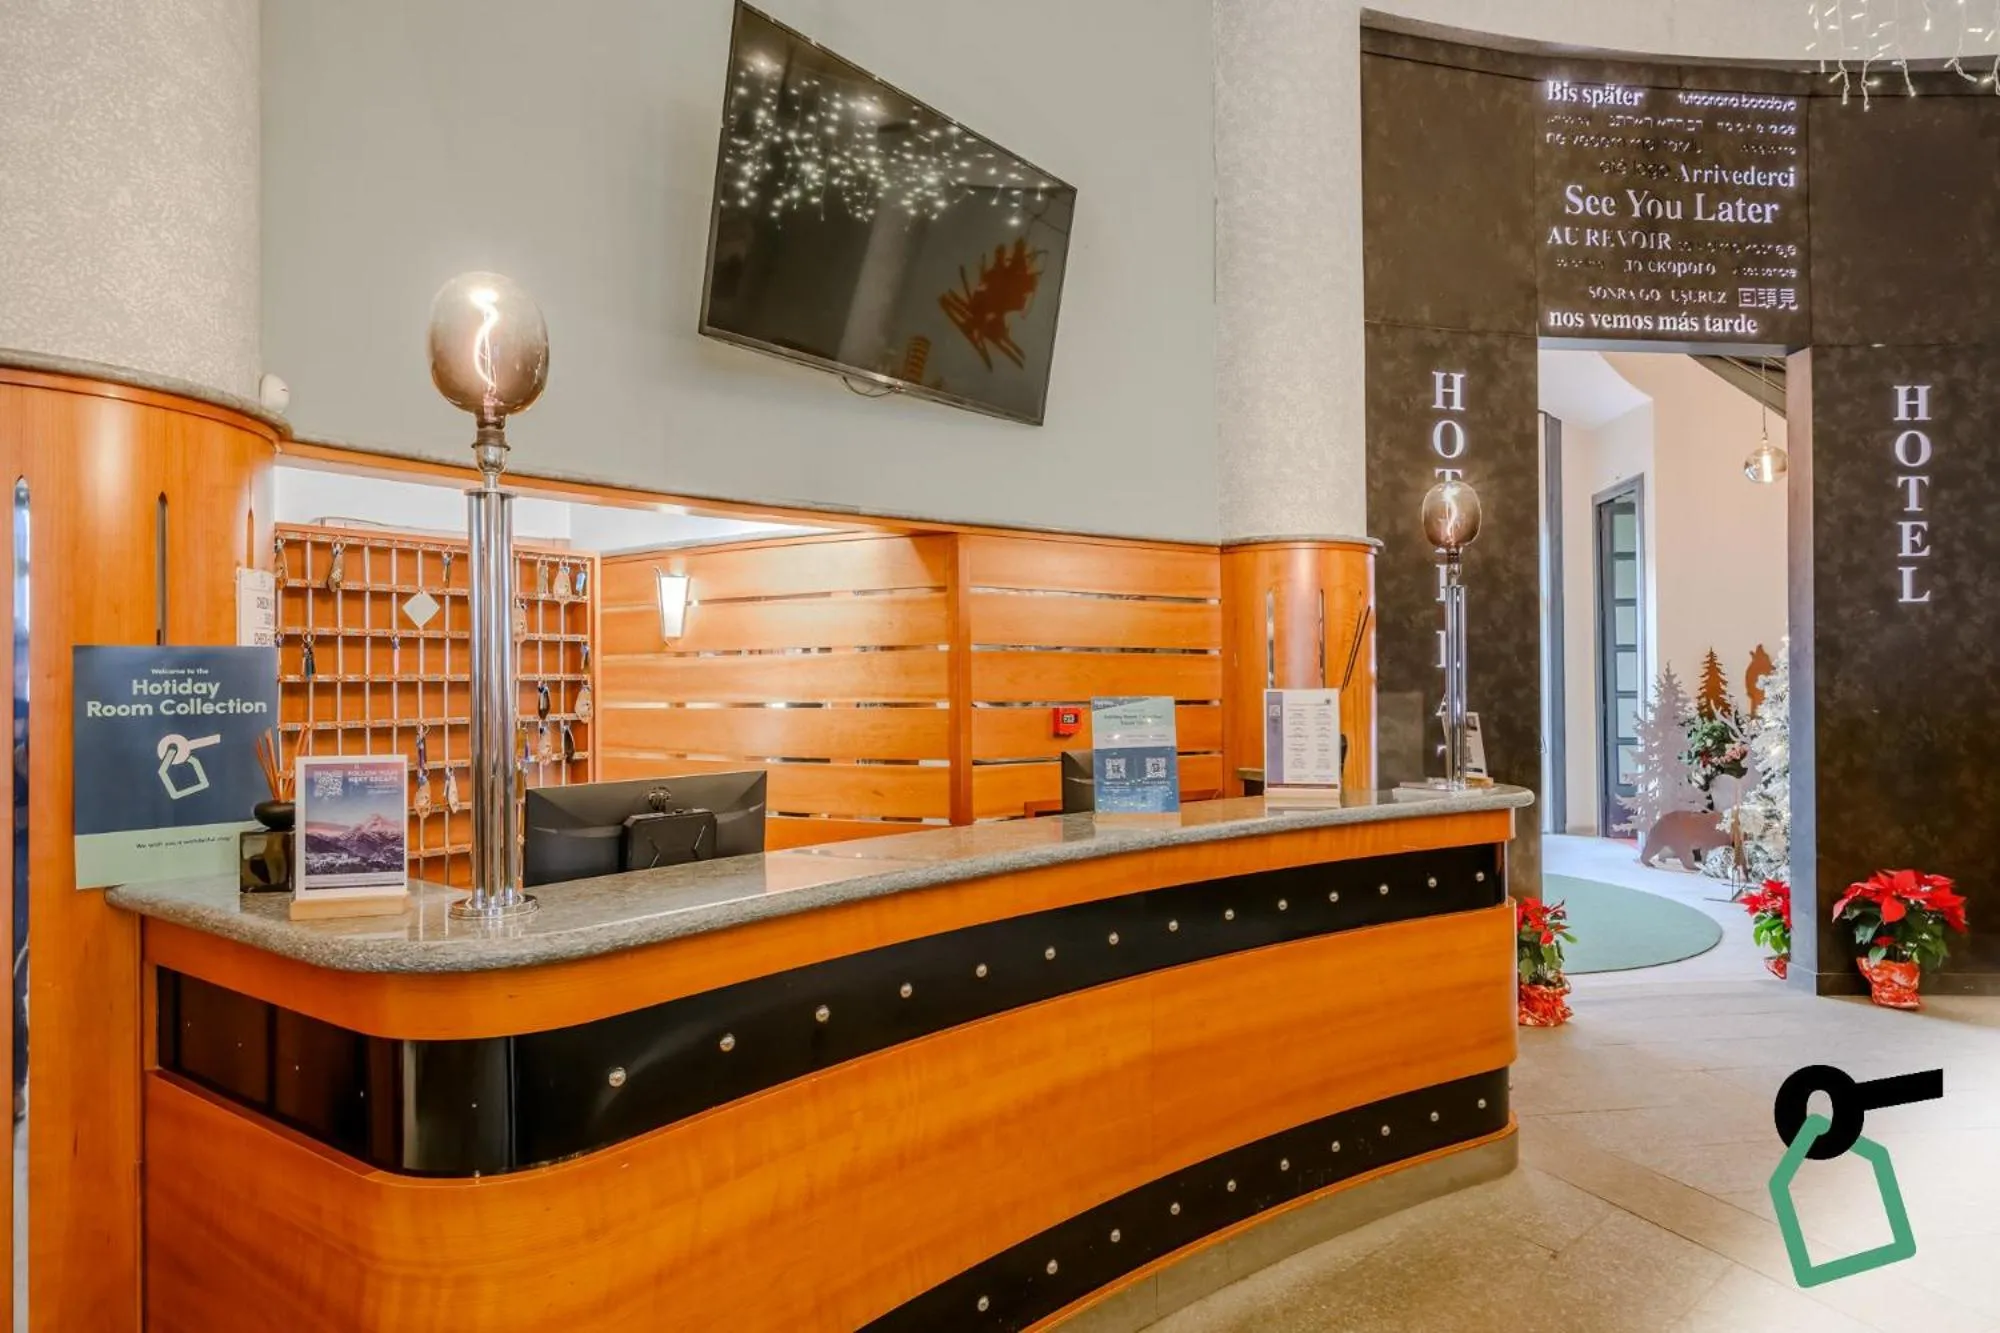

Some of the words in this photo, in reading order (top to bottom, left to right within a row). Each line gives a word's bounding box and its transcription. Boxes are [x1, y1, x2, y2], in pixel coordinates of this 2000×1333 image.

[1547, 80, 1577, 102] Bis
[1582, 83, 1644, 108] später
[1675, 163, 1796, 188] Arrivederci
[1564, 185, 1616, 217] See
[1626, 189, 1682, 220] You
[1694, 193, 1779, 223] Later
[1546, 227, 1580, 246] AU
[1585, 229, 1672, 250] REVOIR
[1549, 311, 1584, 328] nos
[1590, 313, 1652, 331] vemos
[1658, 311, 1700, 332] más
[1704, 313, 1758, 334] tarde
[1893, 384, 1933, 603] HOTEL
[132, 679, 220, 699] Hotiday
[87, 700, 153, 717] Room
[160, 698, 268, 716] Collection
